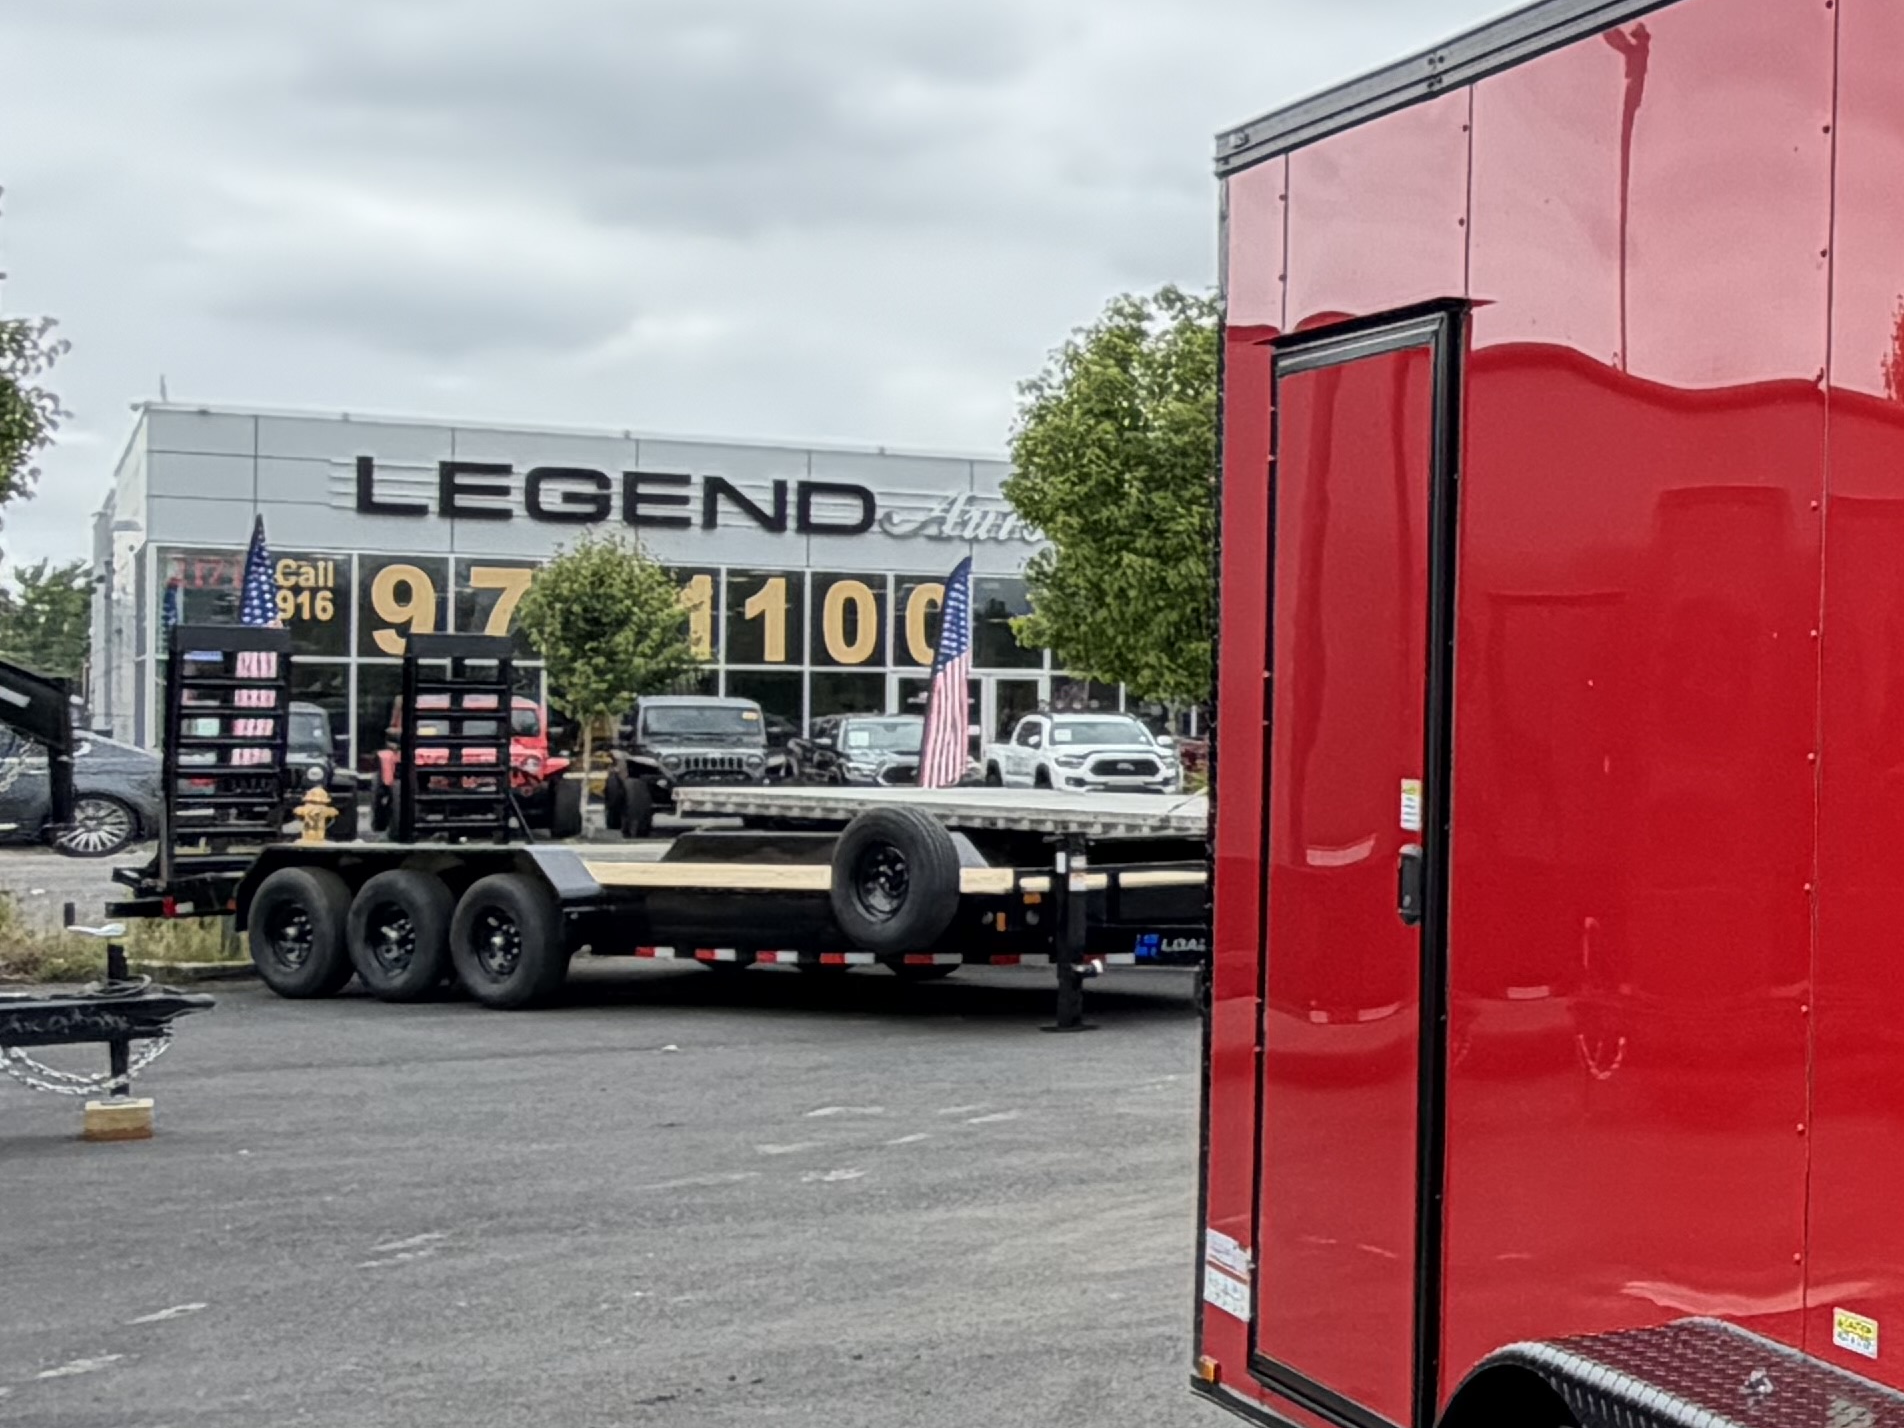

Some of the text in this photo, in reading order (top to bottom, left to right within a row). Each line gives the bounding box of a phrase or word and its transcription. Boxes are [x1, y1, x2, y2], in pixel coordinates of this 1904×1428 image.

[356, 455, 877, 536] LEGEND
[275, 558, 334, 588] Call
[276, 589, 334, 621] 916
